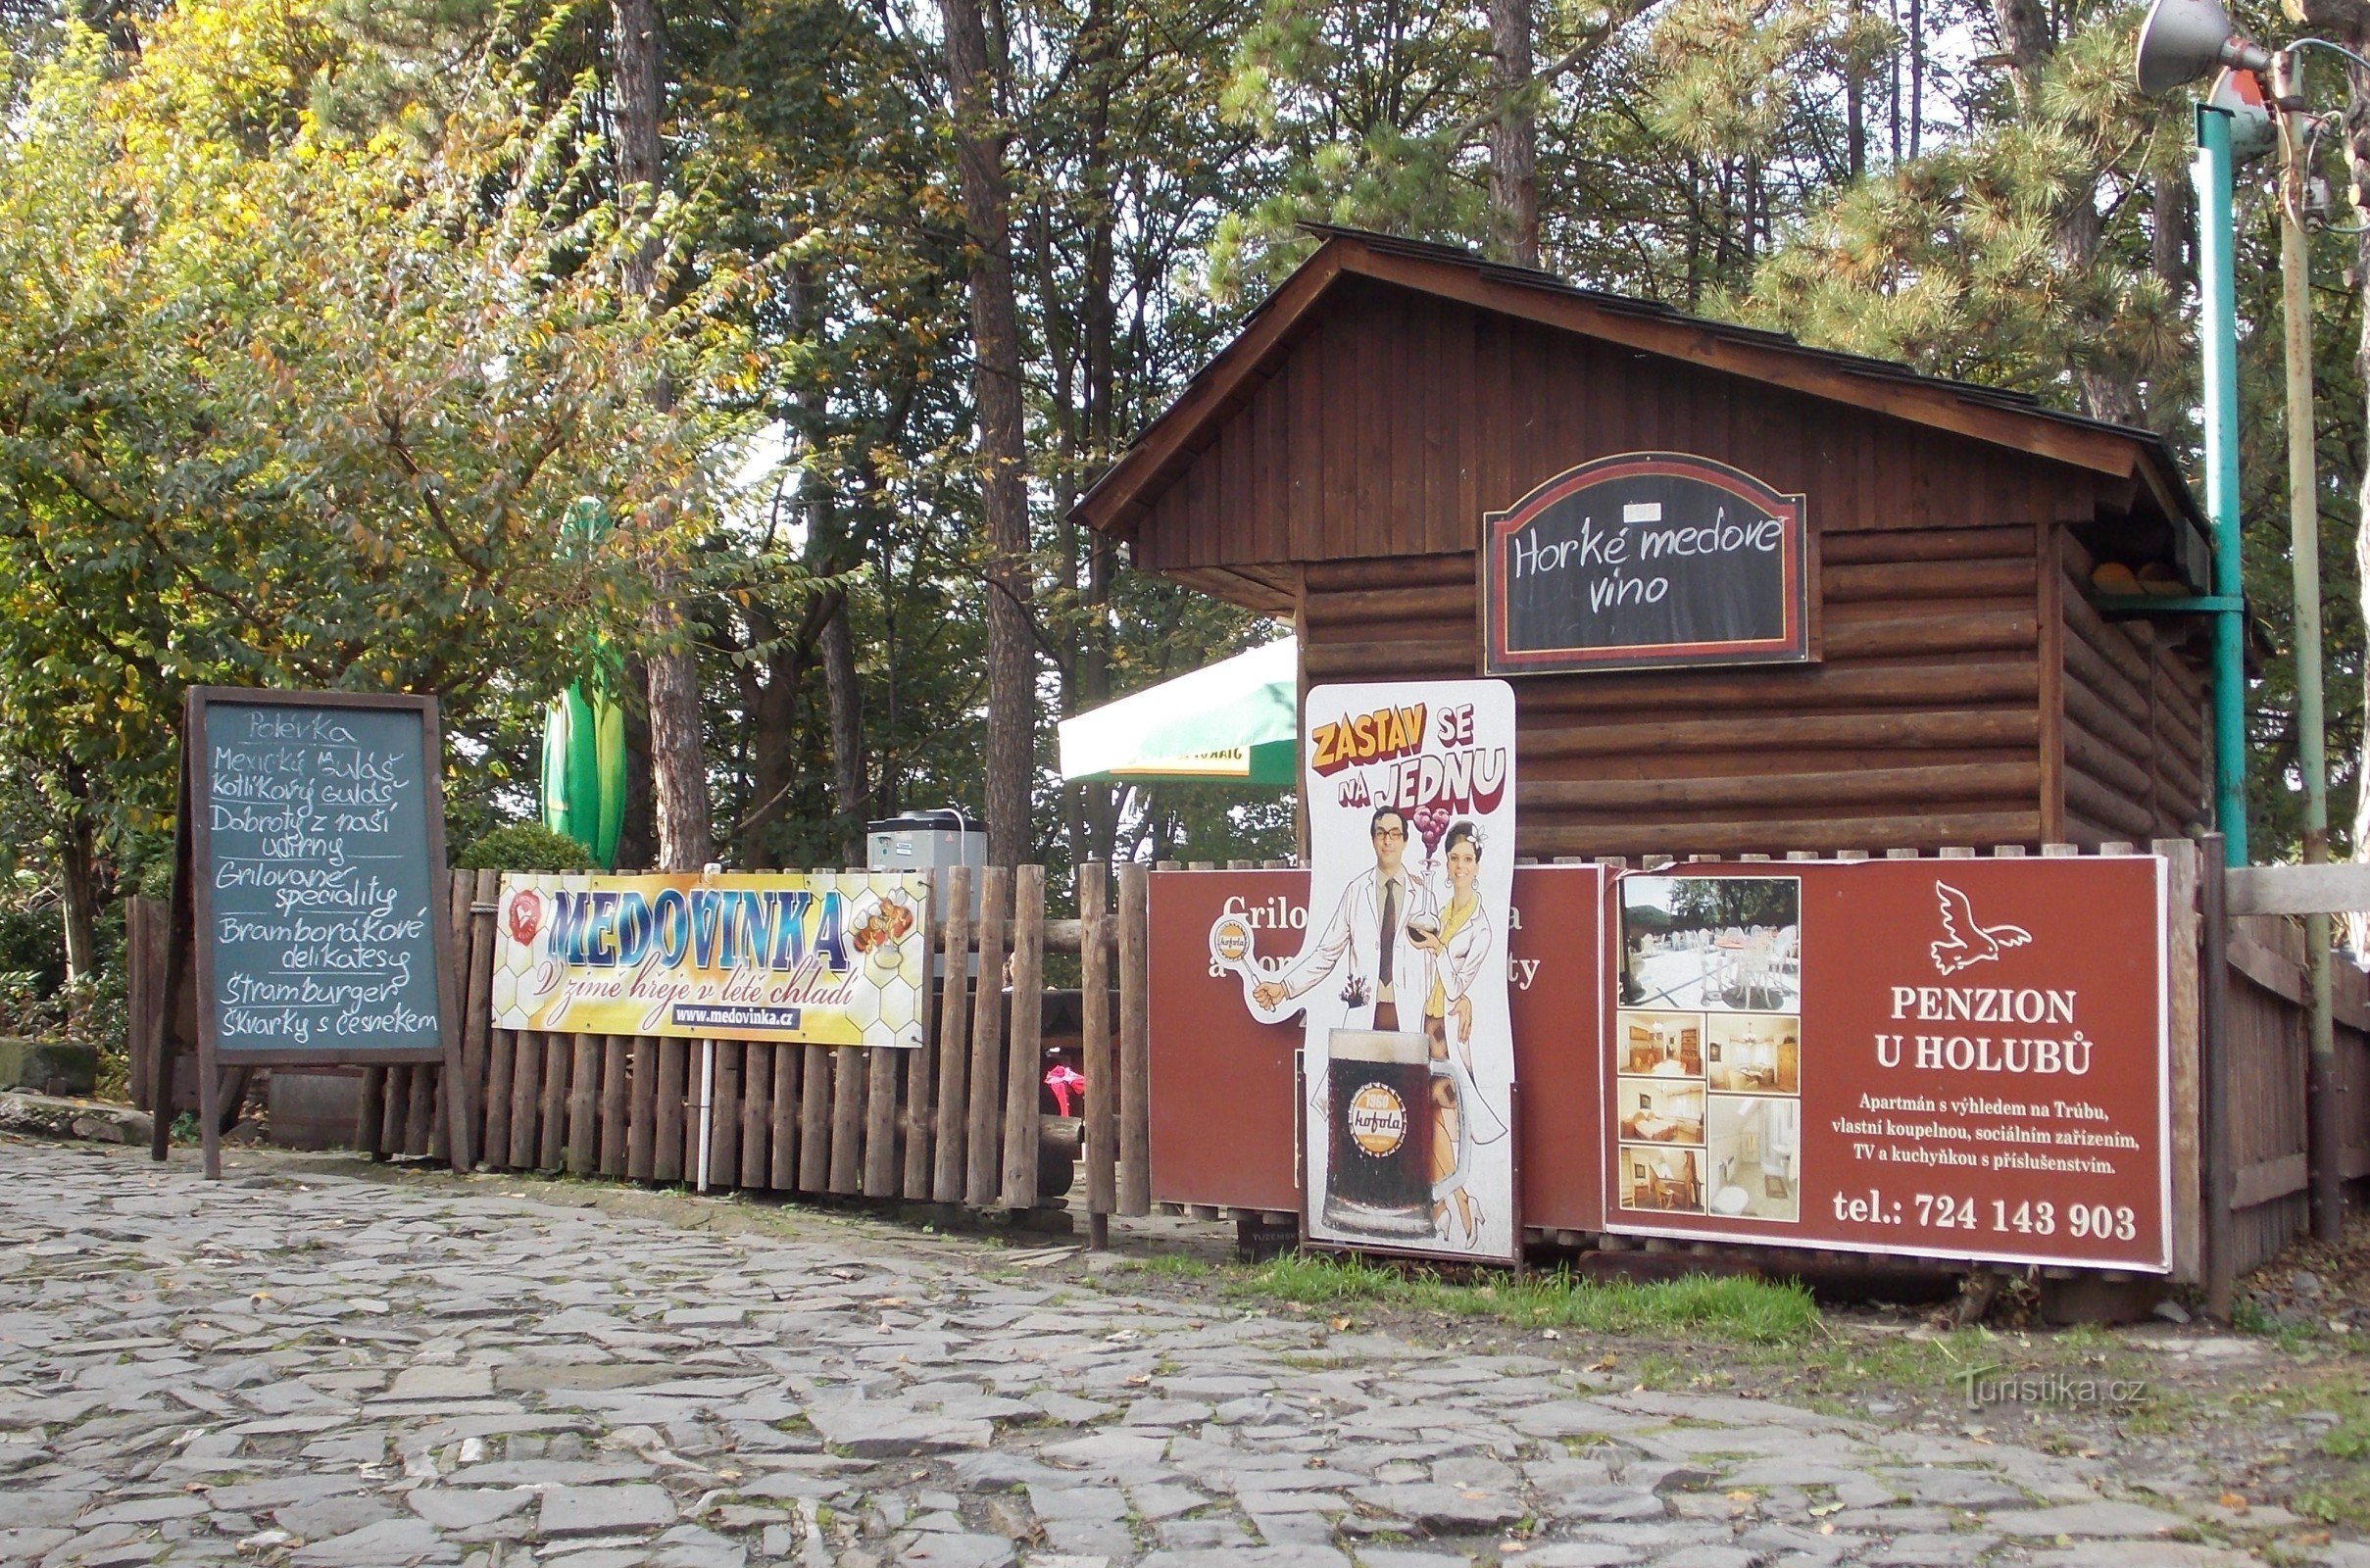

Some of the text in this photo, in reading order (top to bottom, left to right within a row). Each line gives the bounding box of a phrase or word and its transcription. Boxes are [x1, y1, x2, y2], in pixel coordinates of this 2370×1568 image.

[1515, 517, 1630, 578] Horké
[244, 711, 359, 742] Polévka
[1311, 702, 1474, 777] ZASTAV SE
[214, 746, 306, 776] Mexický
[1338, 748, 1506, 816] NA JEDNU
[209, 802, 398, 840] Dobroty z naší
[217, 861, 357, 889] Grilované
[275, 876, 397, 916] speciality
[1222, 896, 1308, 929] Grilo
[219, 906, 427, 944] Bramborákové
[546, 888, 852, 973] MEDOVINKA
[282, 943, 410, 987] delikatesy
[534, 952, 859, 1030] V zimě hřeje v létě chladí
[1891, 986, 2077, 1024] PENZION
[222, 1003, 438, 1043] Škvarky s česnekem
[675, 1007, 794, 1026] www.medovinka.cz
[1875, 1030, 2094, 1075] U HOLUBŮ
[1355, 1109, 1401, 1133] kofola
[1859, 1092, 2109, 1123] Apartmán s výhledem na Trúbu,
[1832, 1117, 2140, 1152] vlastní koupelnou, sociálním zařízením,
[1853, 1143, 2116, 1174] TV a kuchyňkou s příslušenstvím.
[1833, 1189, 2136, 1241] tel.: 724 143 903
